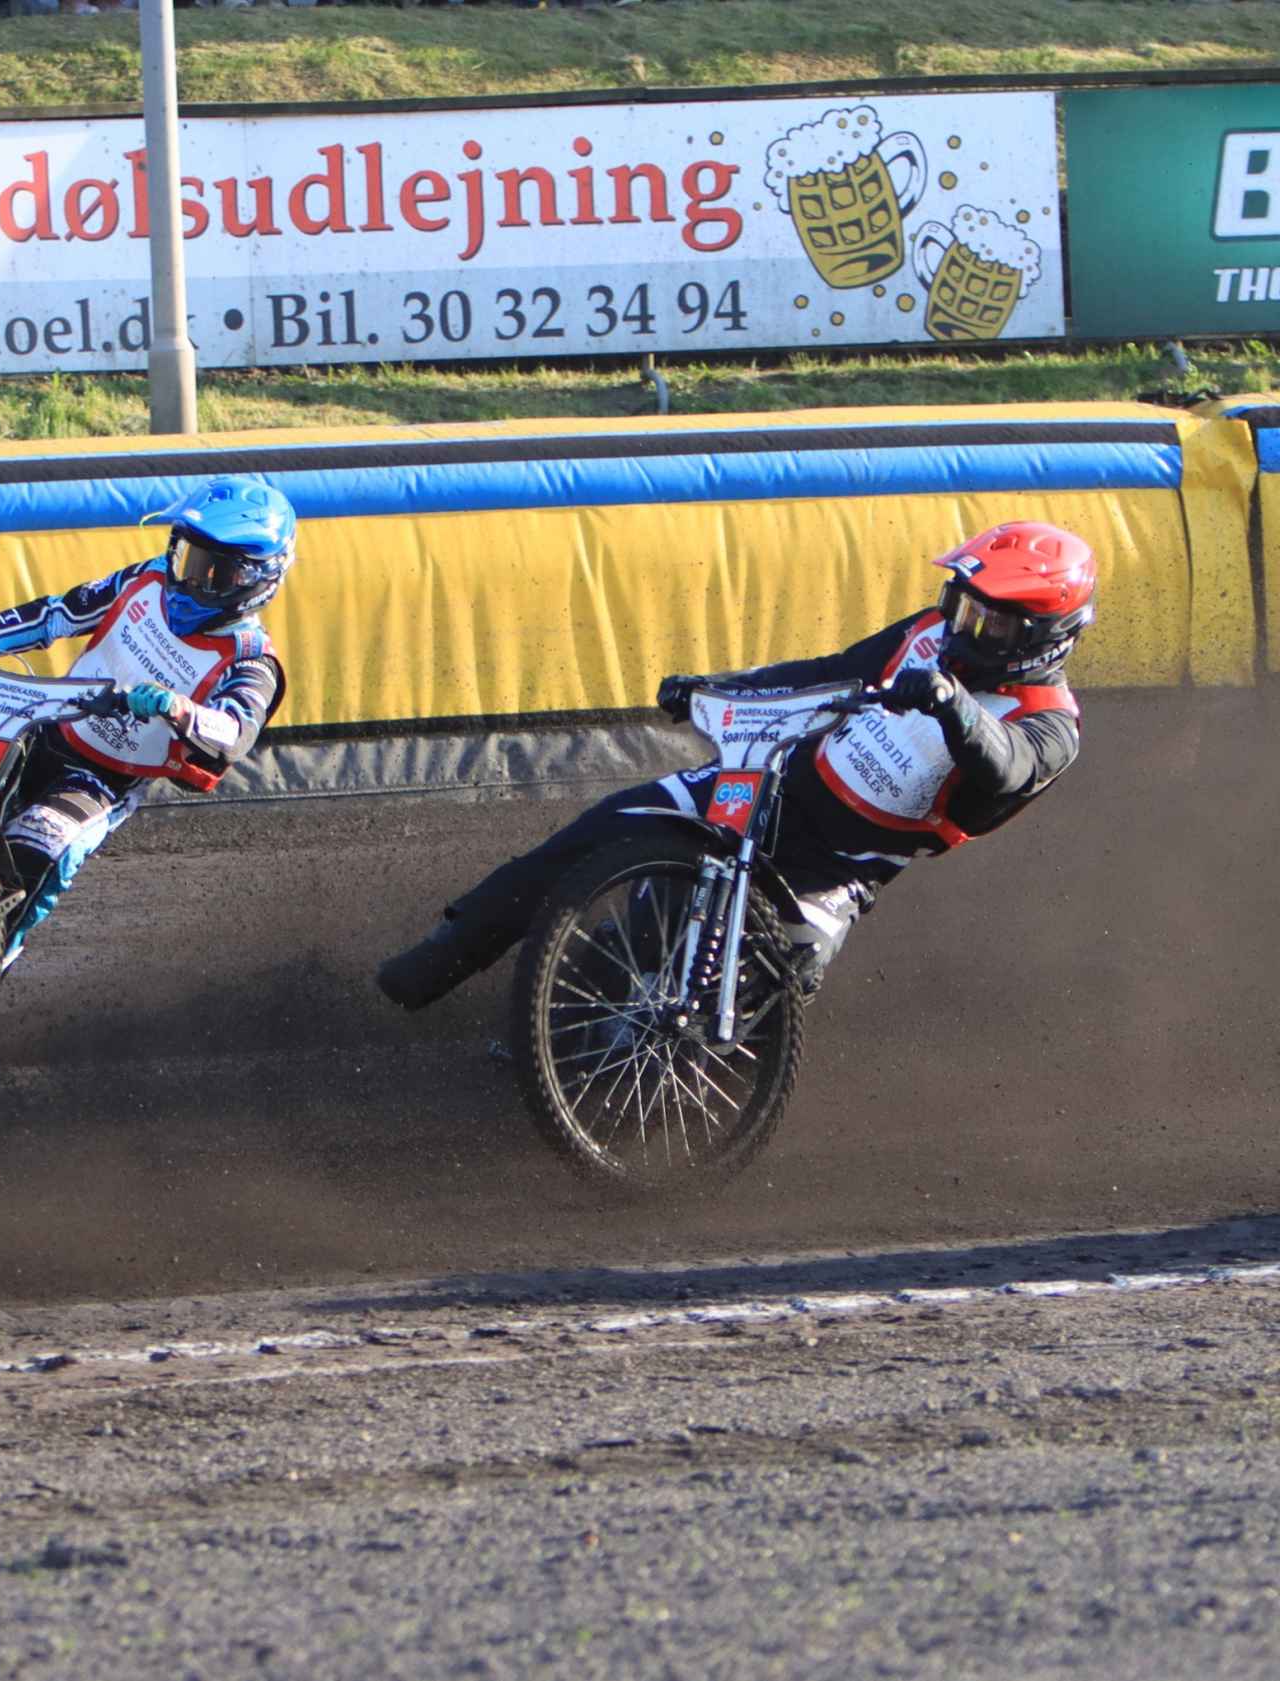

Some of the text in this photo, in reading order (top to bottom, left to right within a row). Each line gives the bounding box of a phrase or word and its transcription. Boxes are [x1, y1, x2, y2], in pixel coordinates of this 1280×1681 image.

[266, 289, 380, 348] Bil.
[402, 289, 473, 345] 30
[494, 286, 566, 341] 32
[586, 282, 657, 338] 34
[677, 279, 749, 334] 94
[120, 624, 176, 690] Sparinvest
[144, 617, 198, 680] SPAREKASSEN
[846, 750, 885, 797] MØBLER
[847, 732, 904, 799] LAURIDSENS
[856, 713, 913, 776] ydbank
